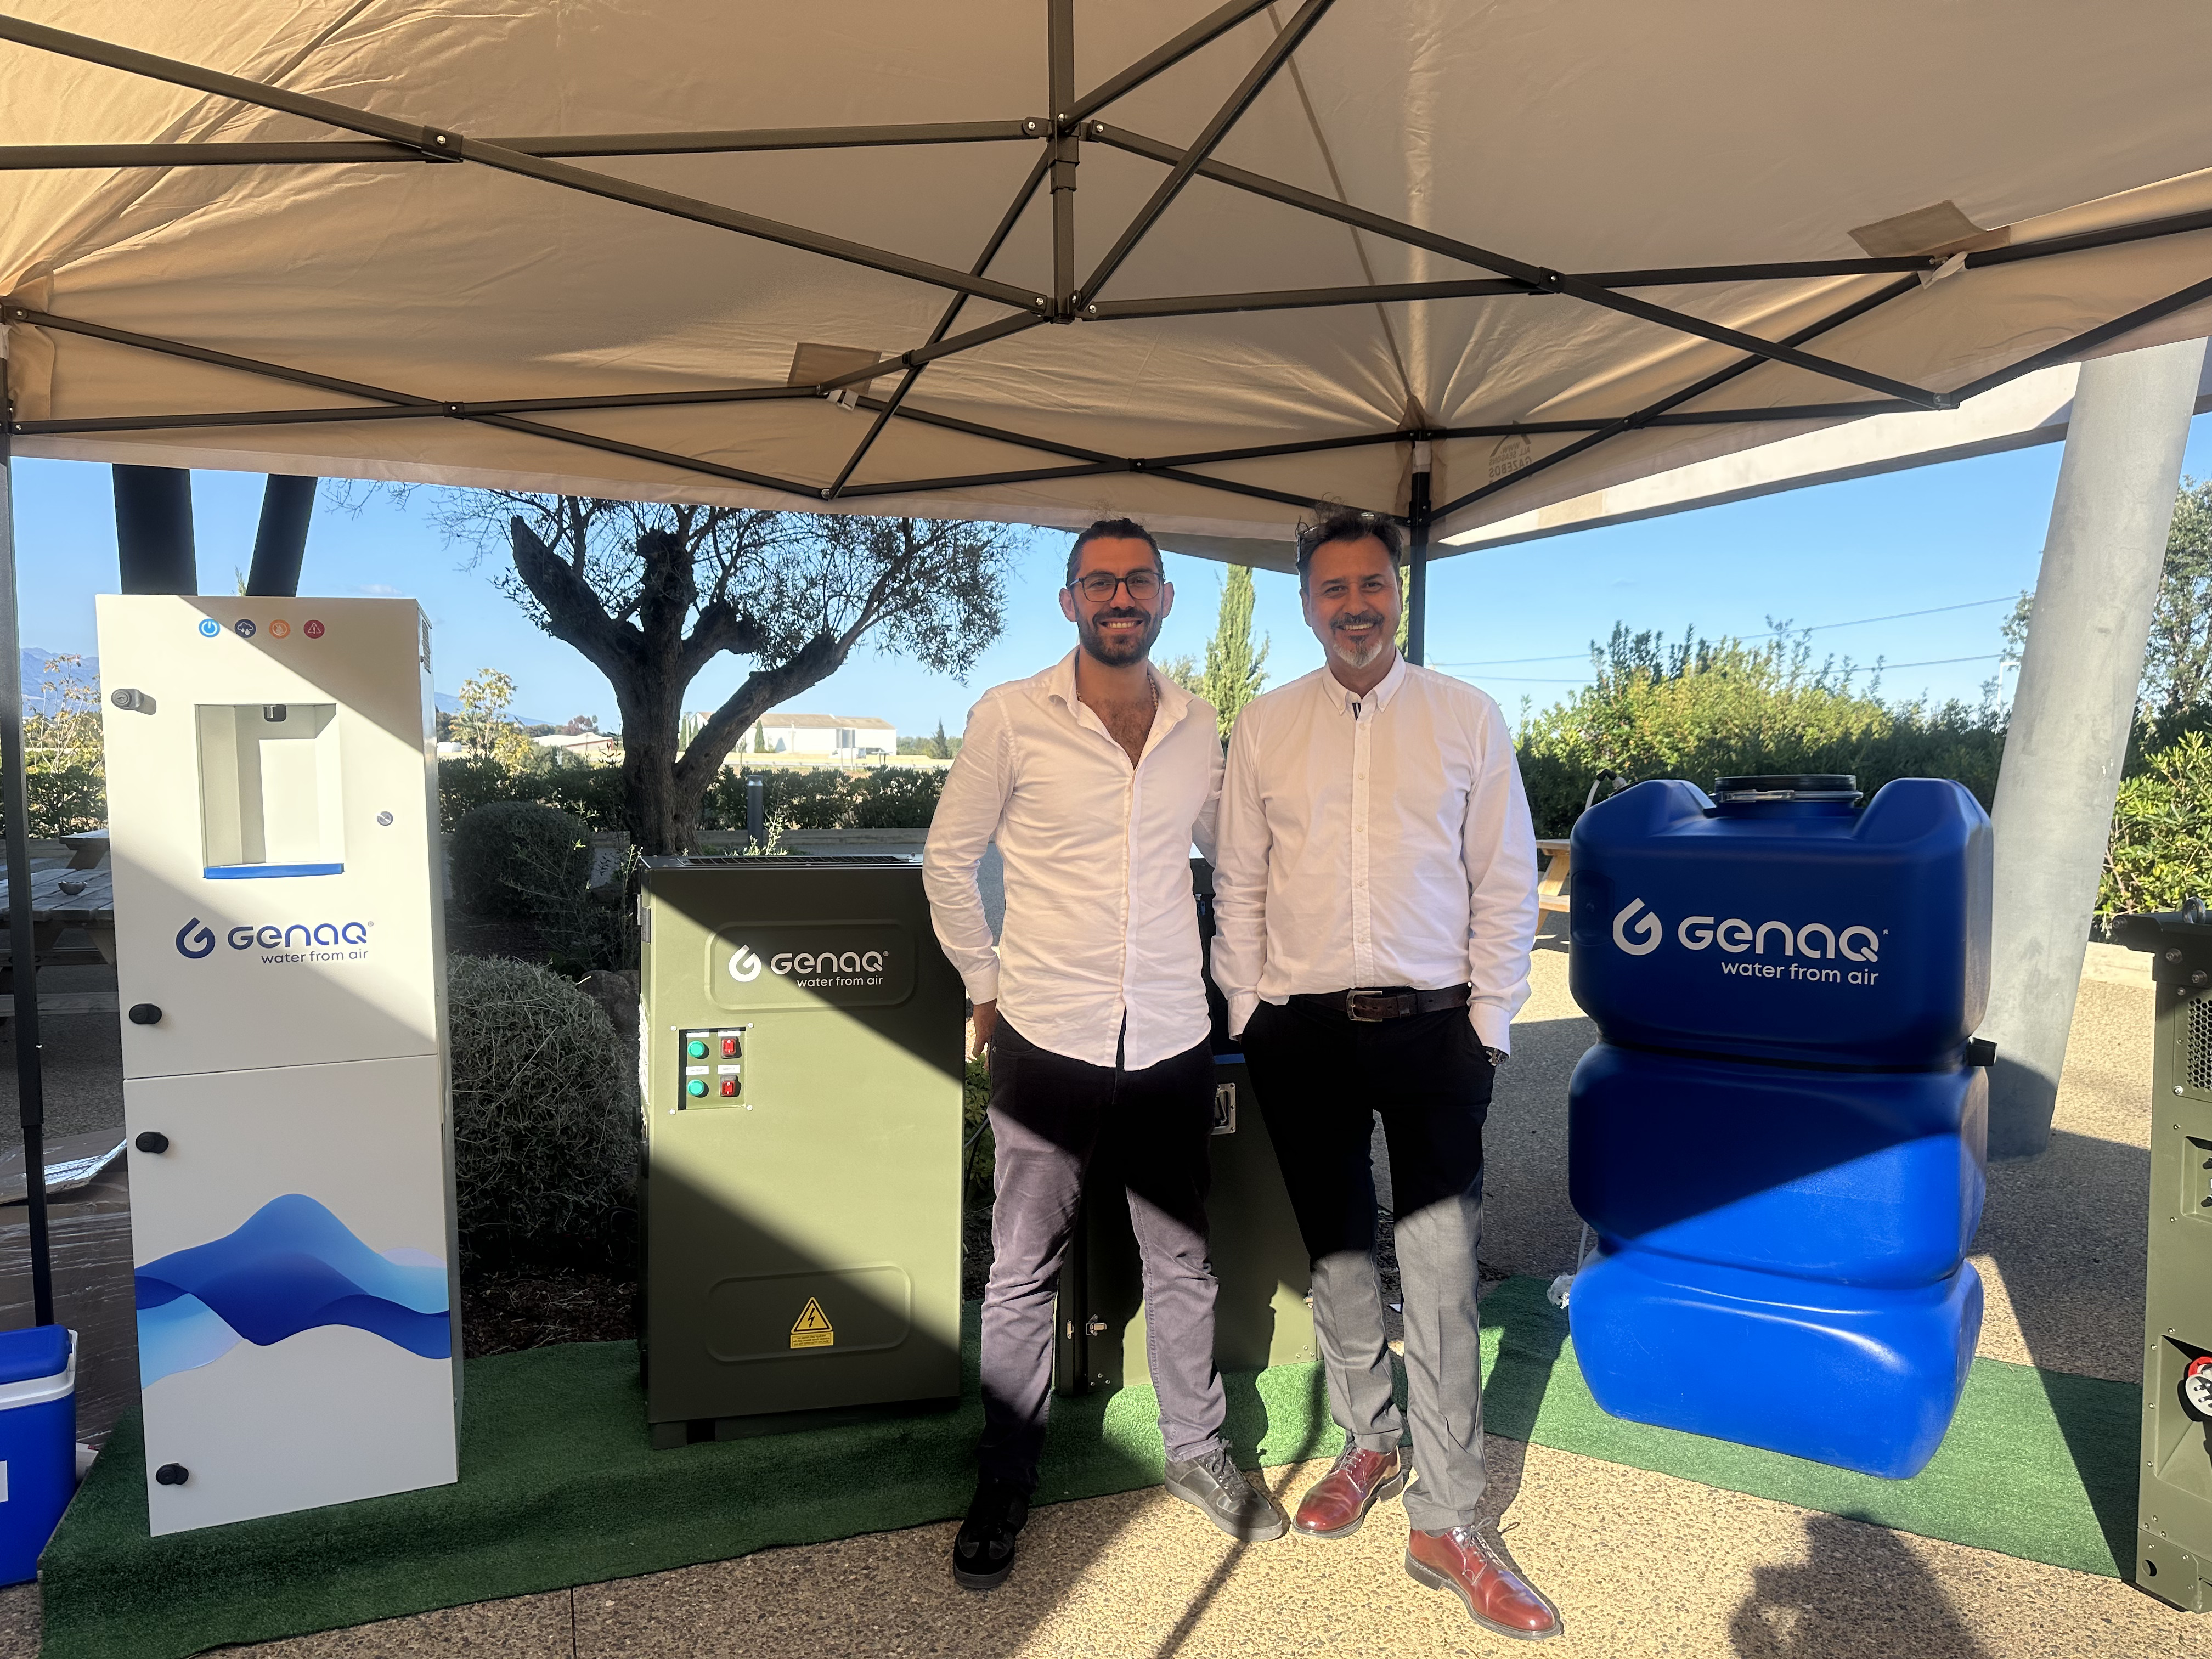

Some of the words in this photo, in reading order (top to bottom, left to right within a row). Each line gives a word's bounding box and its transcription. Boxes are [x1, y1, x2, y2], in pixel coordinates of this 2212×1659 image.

[261, 953, 306, 964] water
[309, 951, 344, 962] from
[348, 949, 369, 960] air
[1721, 962, 1785, 978] water
[1789, 963, 1841, 983] from
[1847, 969, 1879, 985] air
[797, 978, 833, 988] water
[835, 976, 864, 986] from
[867, 975, 883, 985] air
